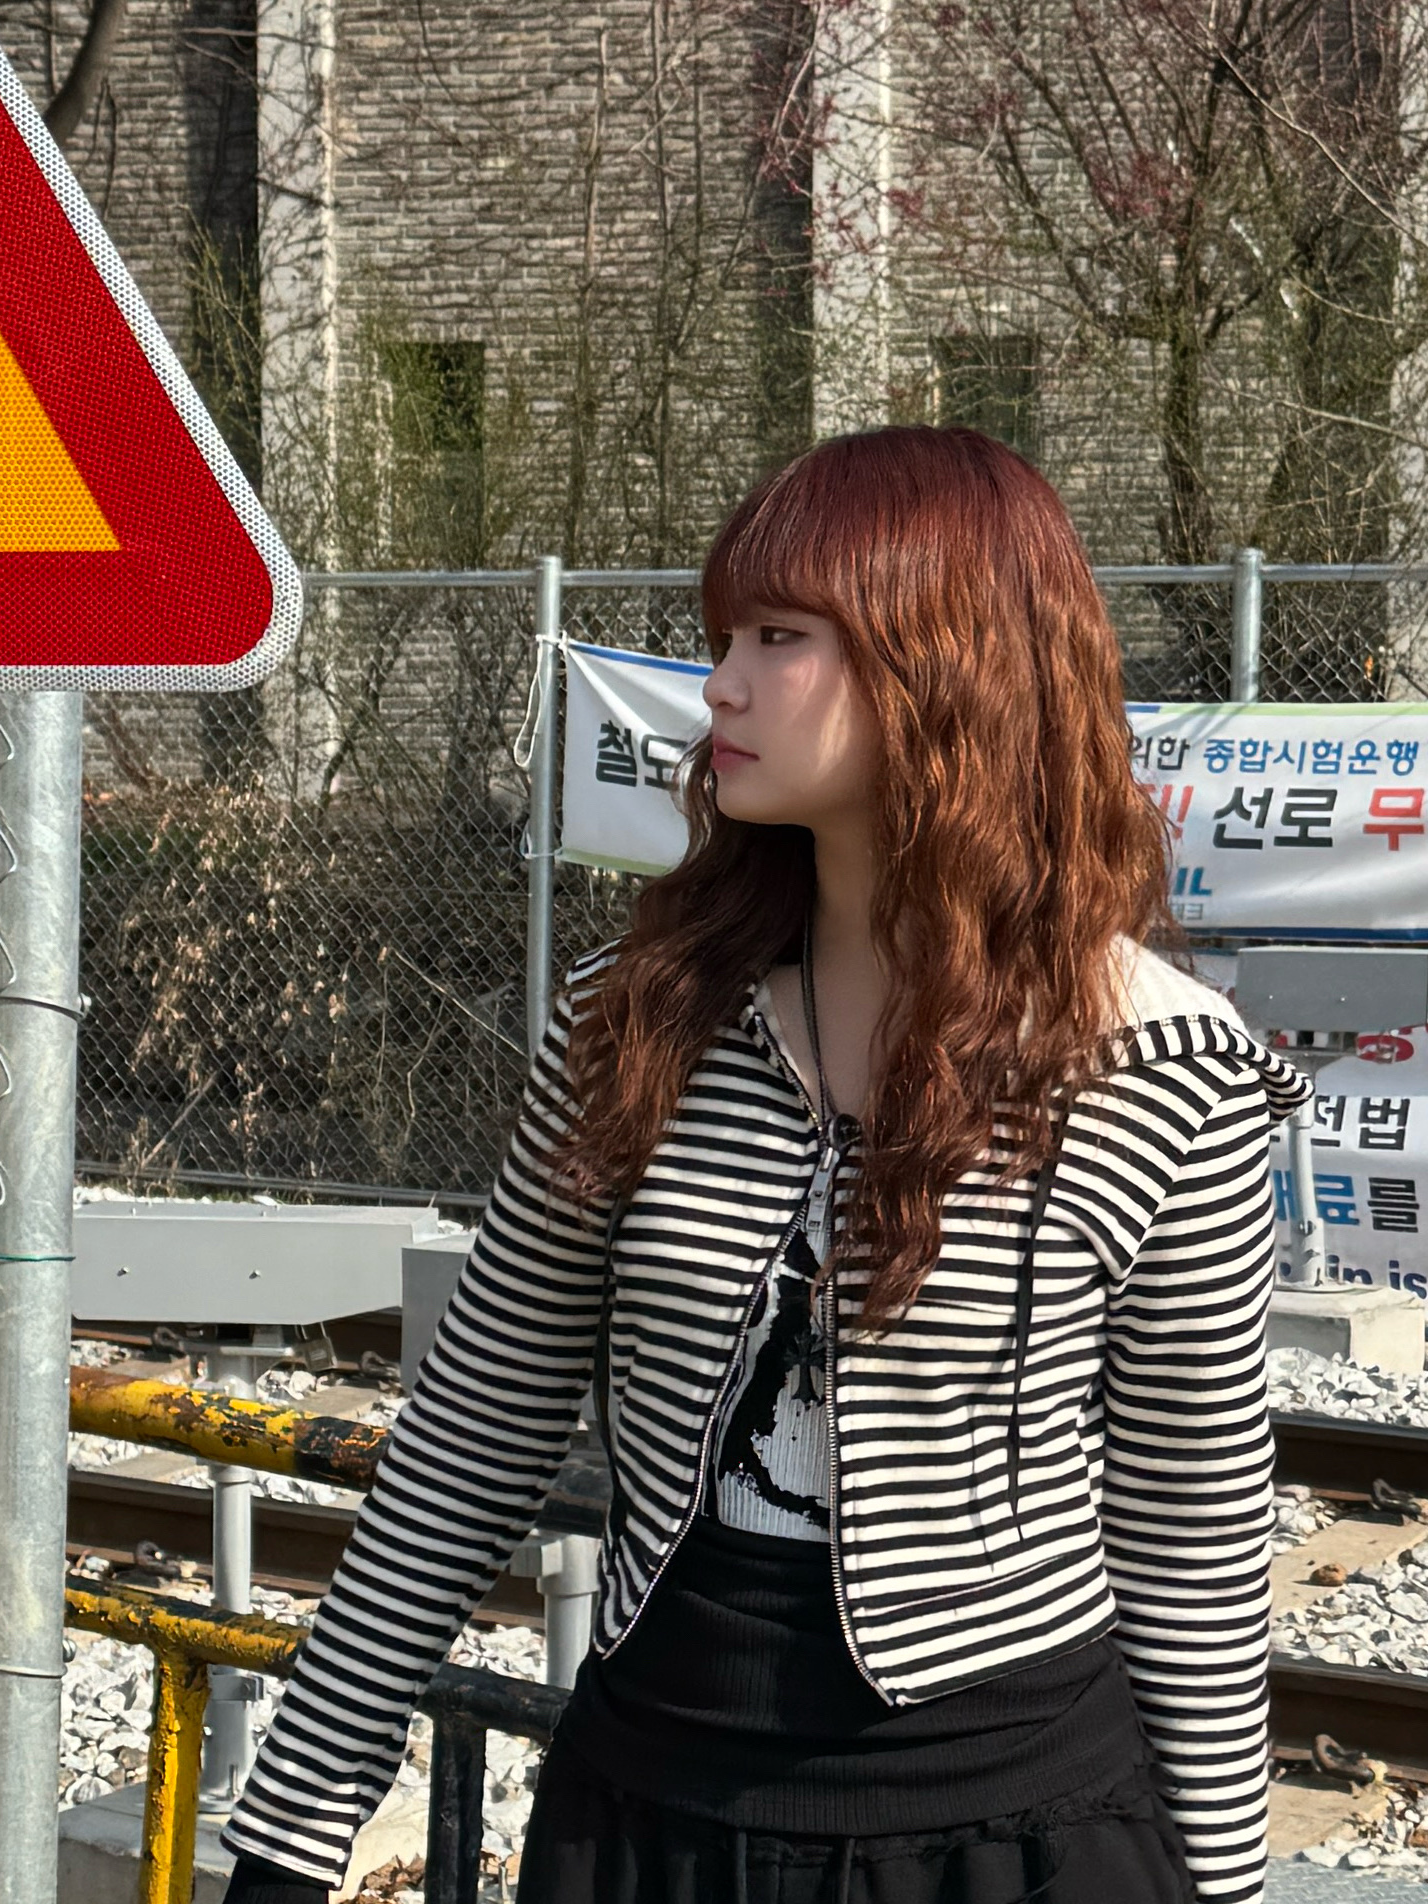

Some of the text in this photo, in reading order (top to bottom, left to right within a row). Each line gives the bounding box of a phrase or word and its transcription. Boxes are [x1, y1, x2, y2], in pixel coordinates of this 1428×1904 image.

[1202, 737, 1419, 776] 종합시험운행
[1212, 785, 1339, 850] 선로
[1270, 1094, 1411, 1151] 전법
[1388, 1259, 1428, 1300] is
